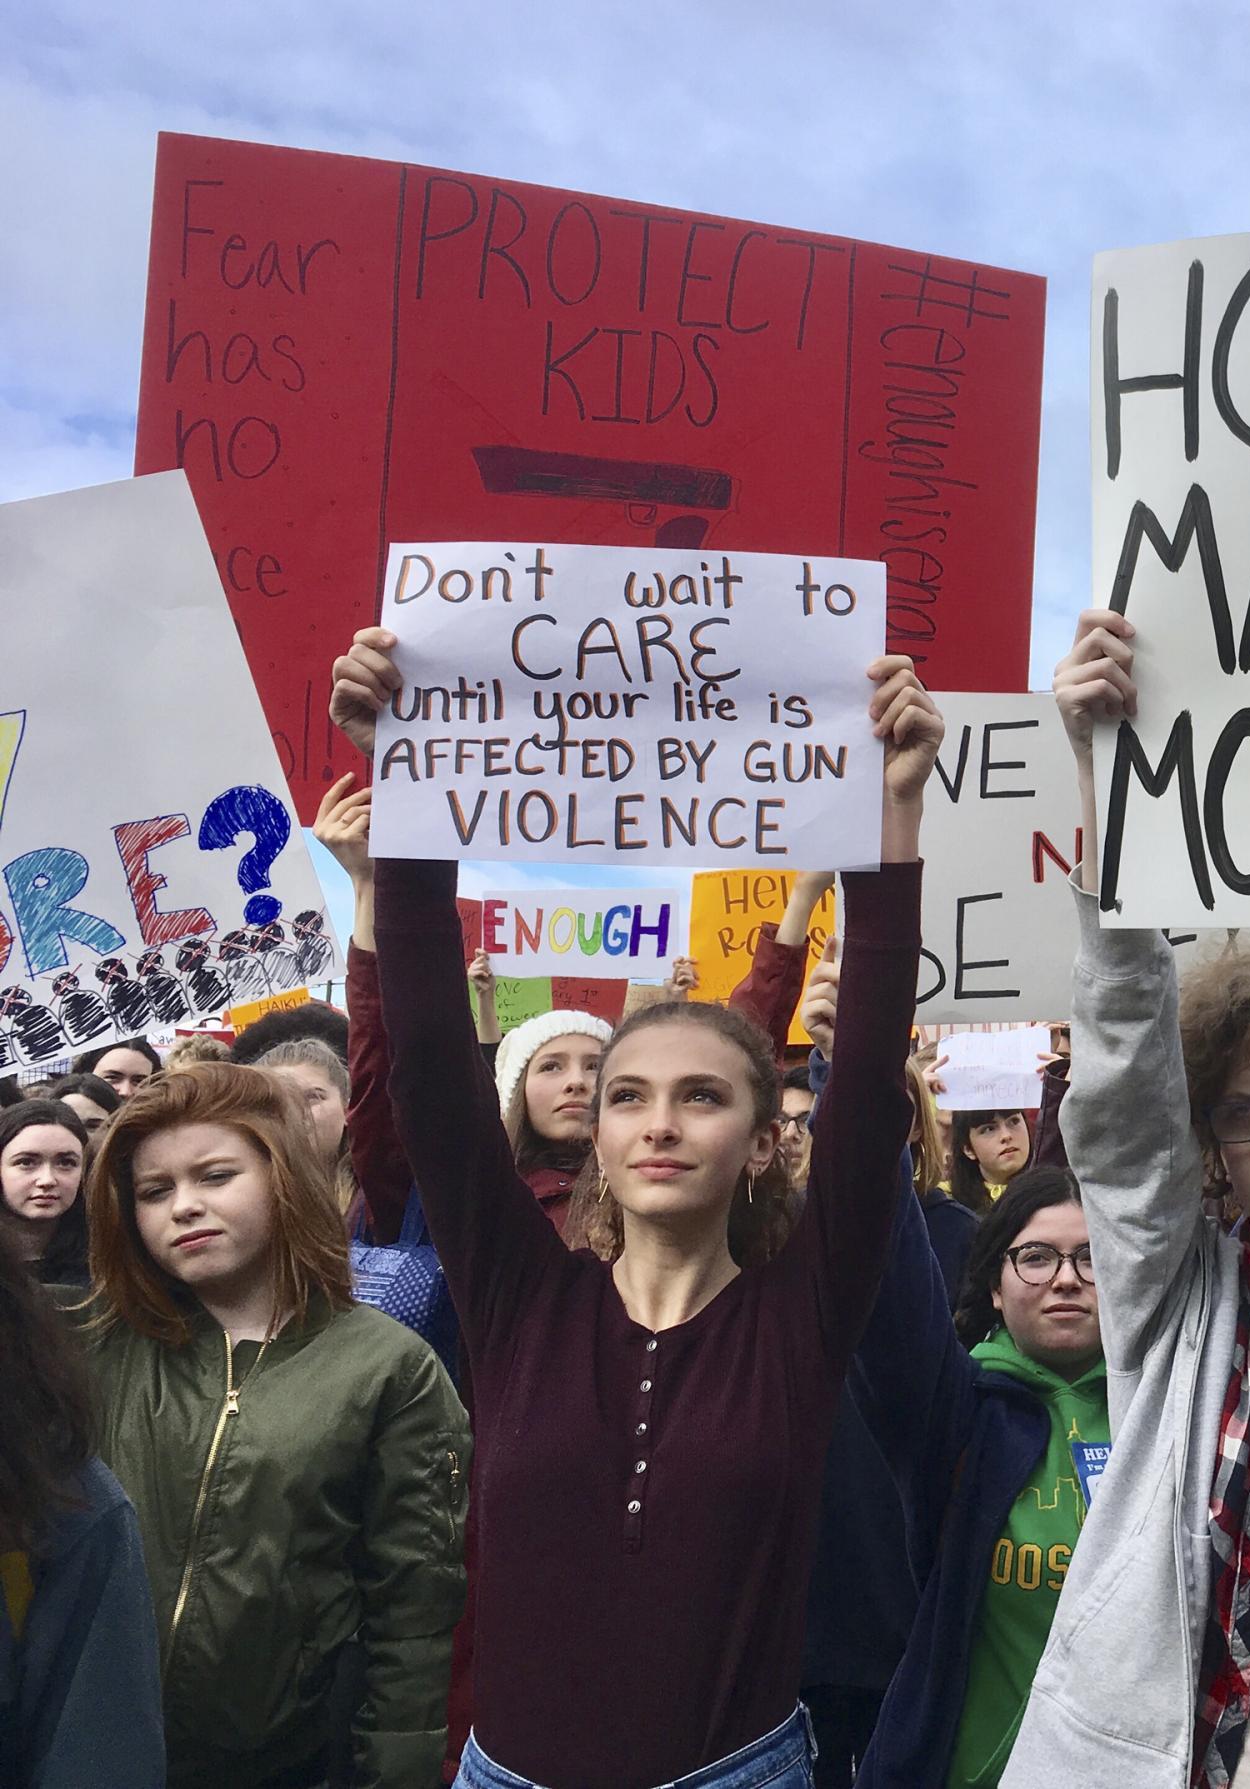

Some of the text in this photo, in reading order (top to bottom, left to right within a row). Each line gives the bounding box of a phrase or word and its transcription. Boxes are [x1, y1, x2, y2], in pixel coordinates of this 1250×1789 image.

[181, 179, 340, 295] Fear
[415, 175, 846, 351] PROTECT
[166, 299, 306, 393] has
[542, 320, 720, 428] KIDS
[174, 409, 282, 482] no
[394, 548, 857, 617] Don't wait to
[512, 614, 741, 684] CARE
[391, 676, 813, 748] until your life is
[380, 736, 849, 785] AFFECTED BY GUN
[446, 789, 789, 856] VIOLENCE
[483, 899, 671, 958] ENOUGH
